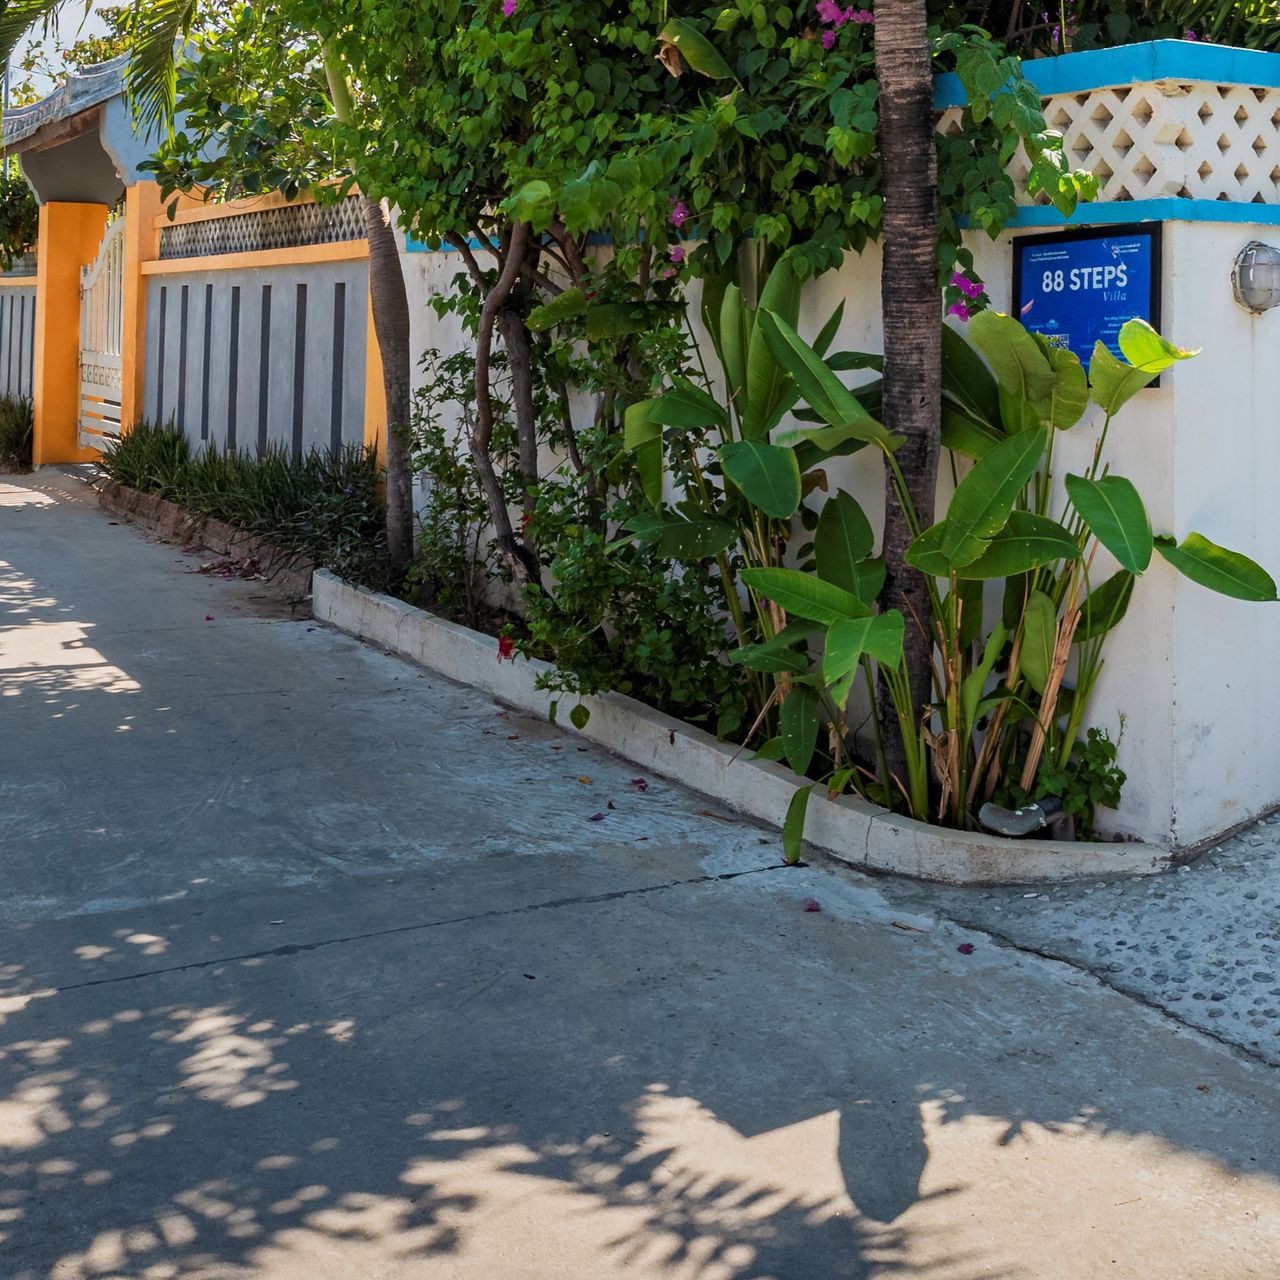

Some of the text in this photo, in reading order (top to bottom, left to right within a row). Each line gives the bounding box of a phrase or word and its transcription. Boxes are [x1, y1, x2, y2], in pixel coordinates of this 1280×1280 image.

[1042, 265, 1128, 292] 88 STEPS
[1104, 291, 1127, 301] Villa
